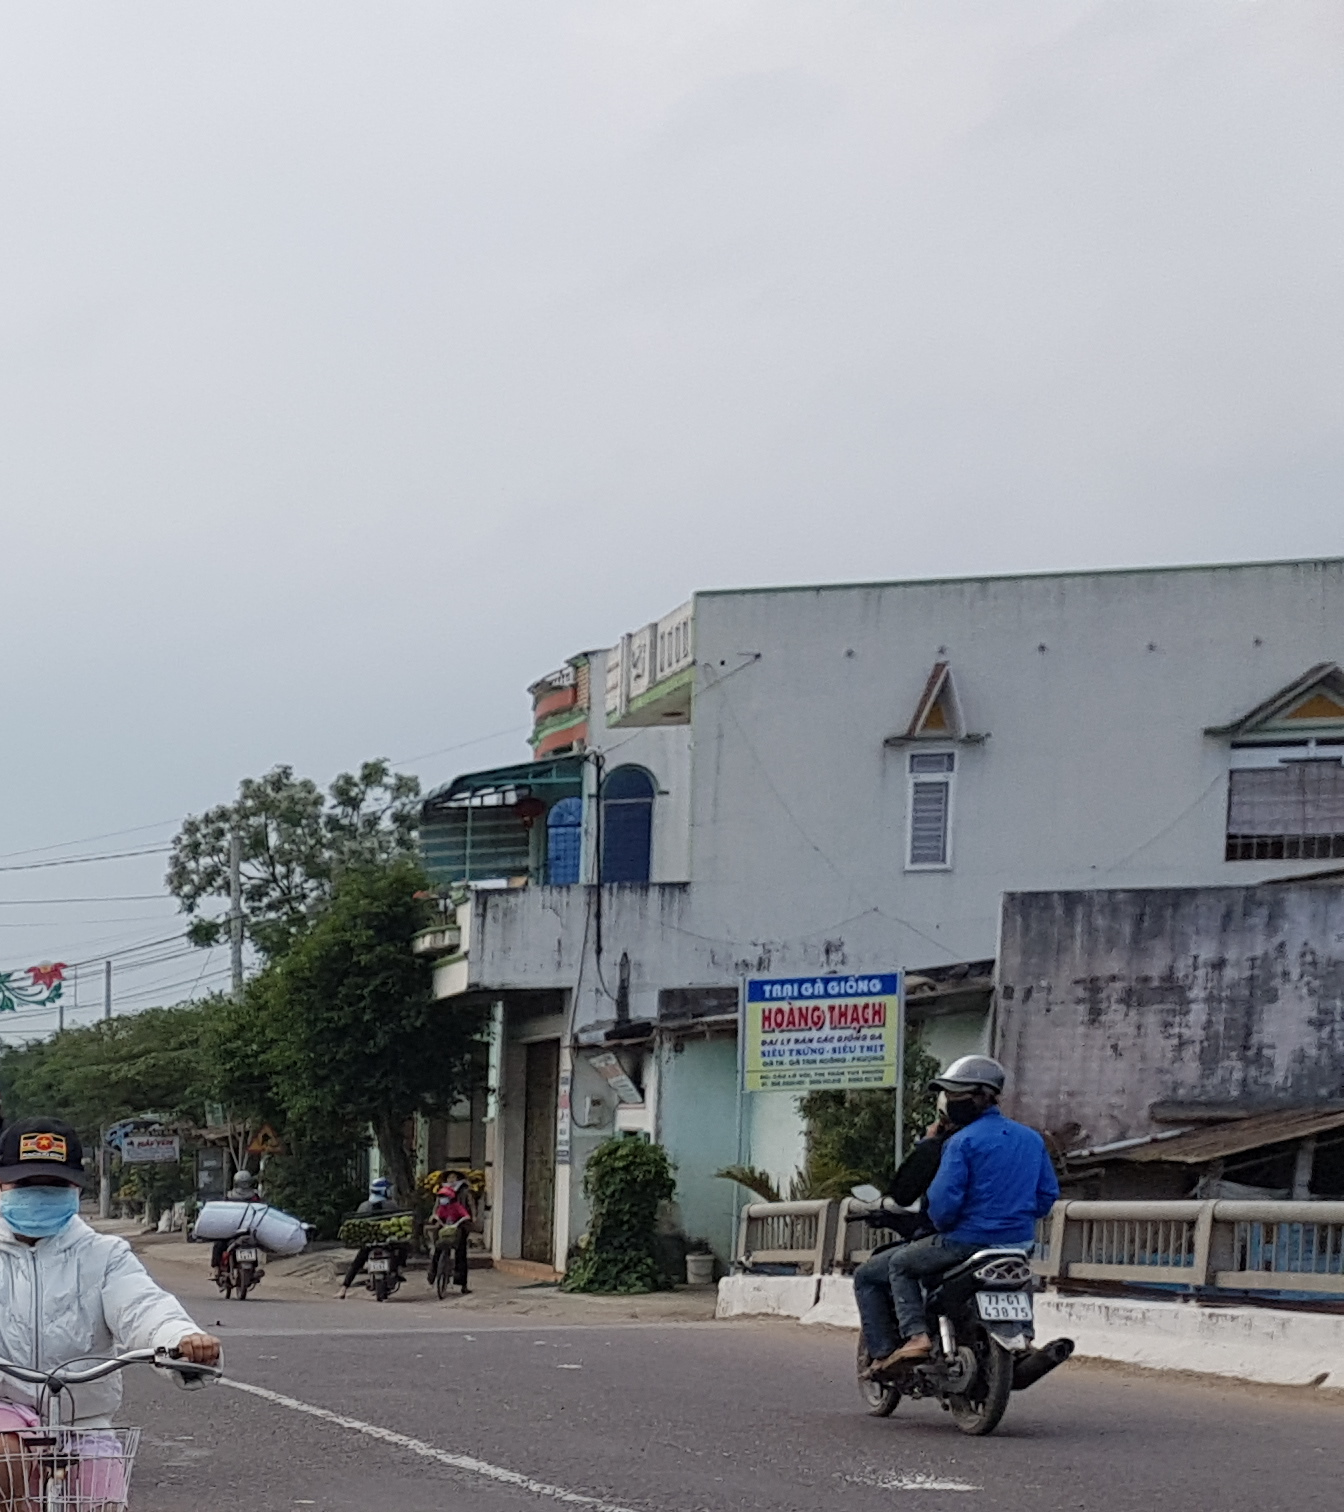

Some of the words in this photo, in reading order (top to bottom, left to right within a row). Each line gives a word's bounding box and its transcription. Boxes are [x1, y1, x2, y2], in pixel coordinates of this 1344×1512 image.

[800, 978, 825, 996] GÀ
[761, 1002, 826, 1031] HOÀNG
[828, 1002, 886, 1033] THẠCH
